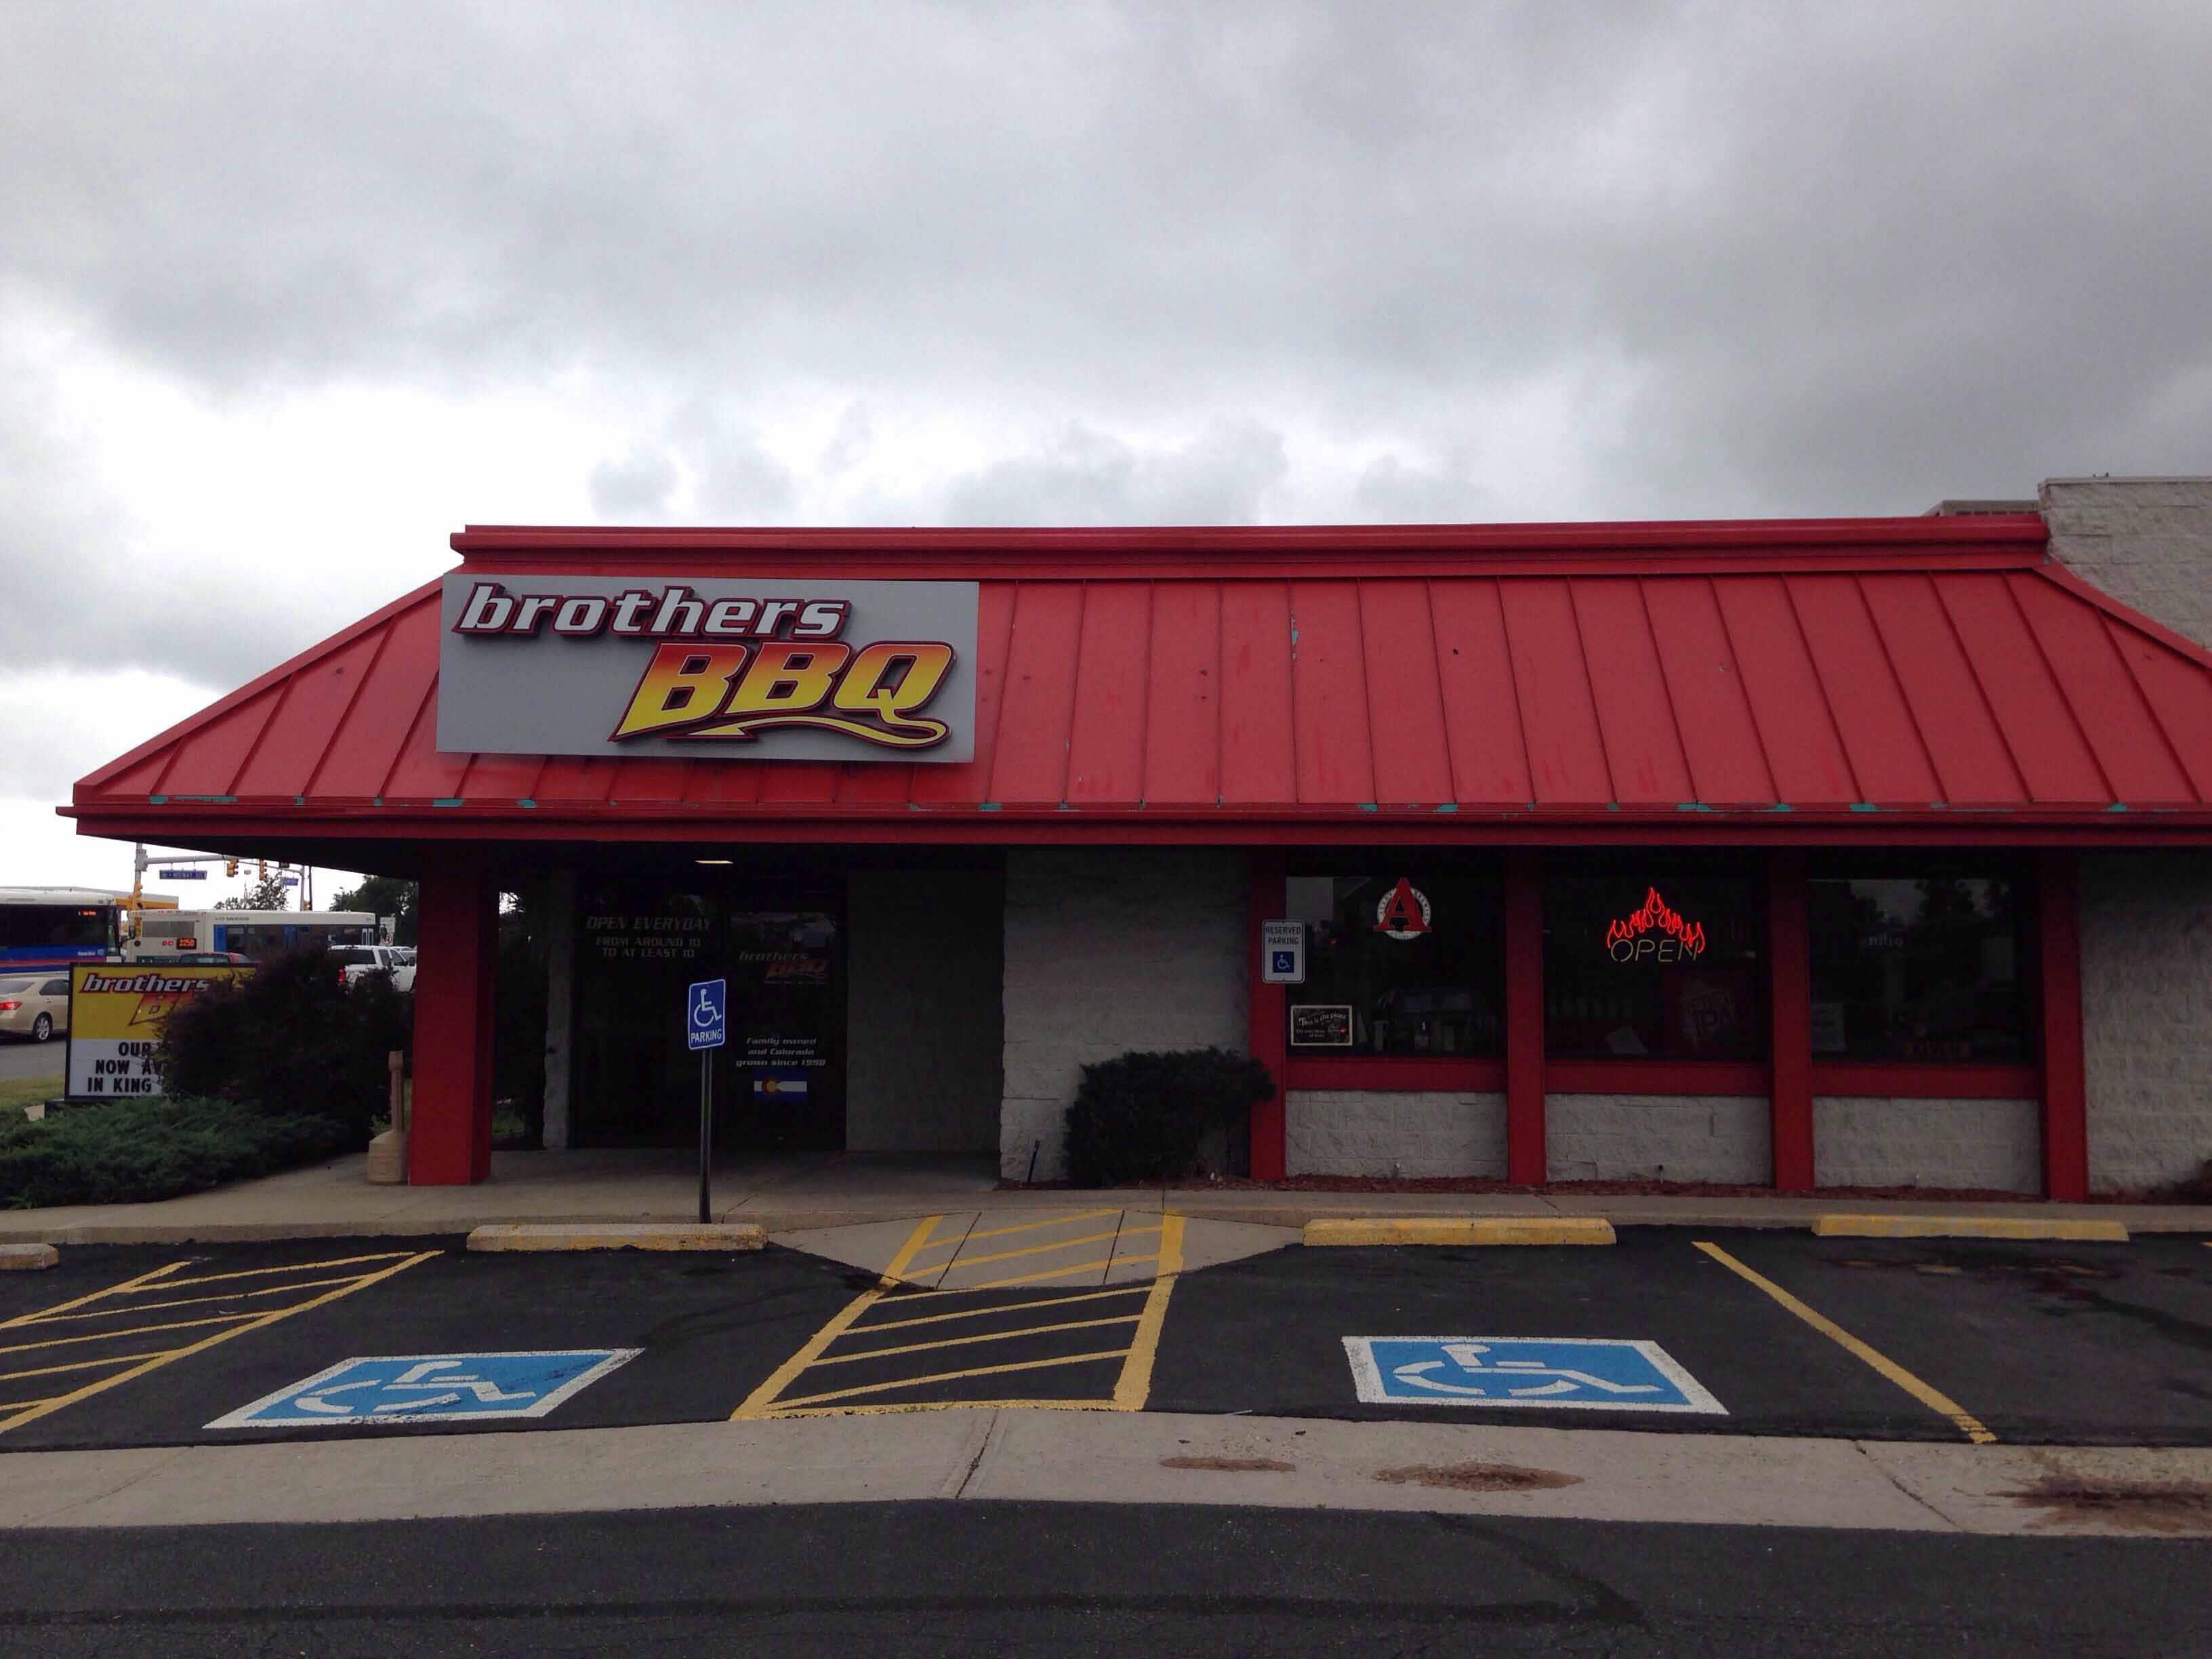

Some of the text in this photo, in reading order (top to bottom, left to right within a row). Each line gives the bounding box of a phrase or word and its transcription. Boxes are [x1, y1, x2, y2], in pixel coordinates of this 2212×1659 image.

[453, 582, 851, 638] brothers
[609, 640, 955, 748] BBQ
[586, 916, 712, 932] OPEN EVERYDAY
[1610, 939, 1700, 962] OPEN
[79, 972, 210, 994] brothers
[691, 1029, 722, 1044] PARKING
[746, 1037, 780, 1046] Family
[119, 1042, 152, 1057] OUR
[96, 1059, 130, 1074] NOW
[771, 1059, 798, 1067] since
[87, 1078, 152, 1092] IN KING
